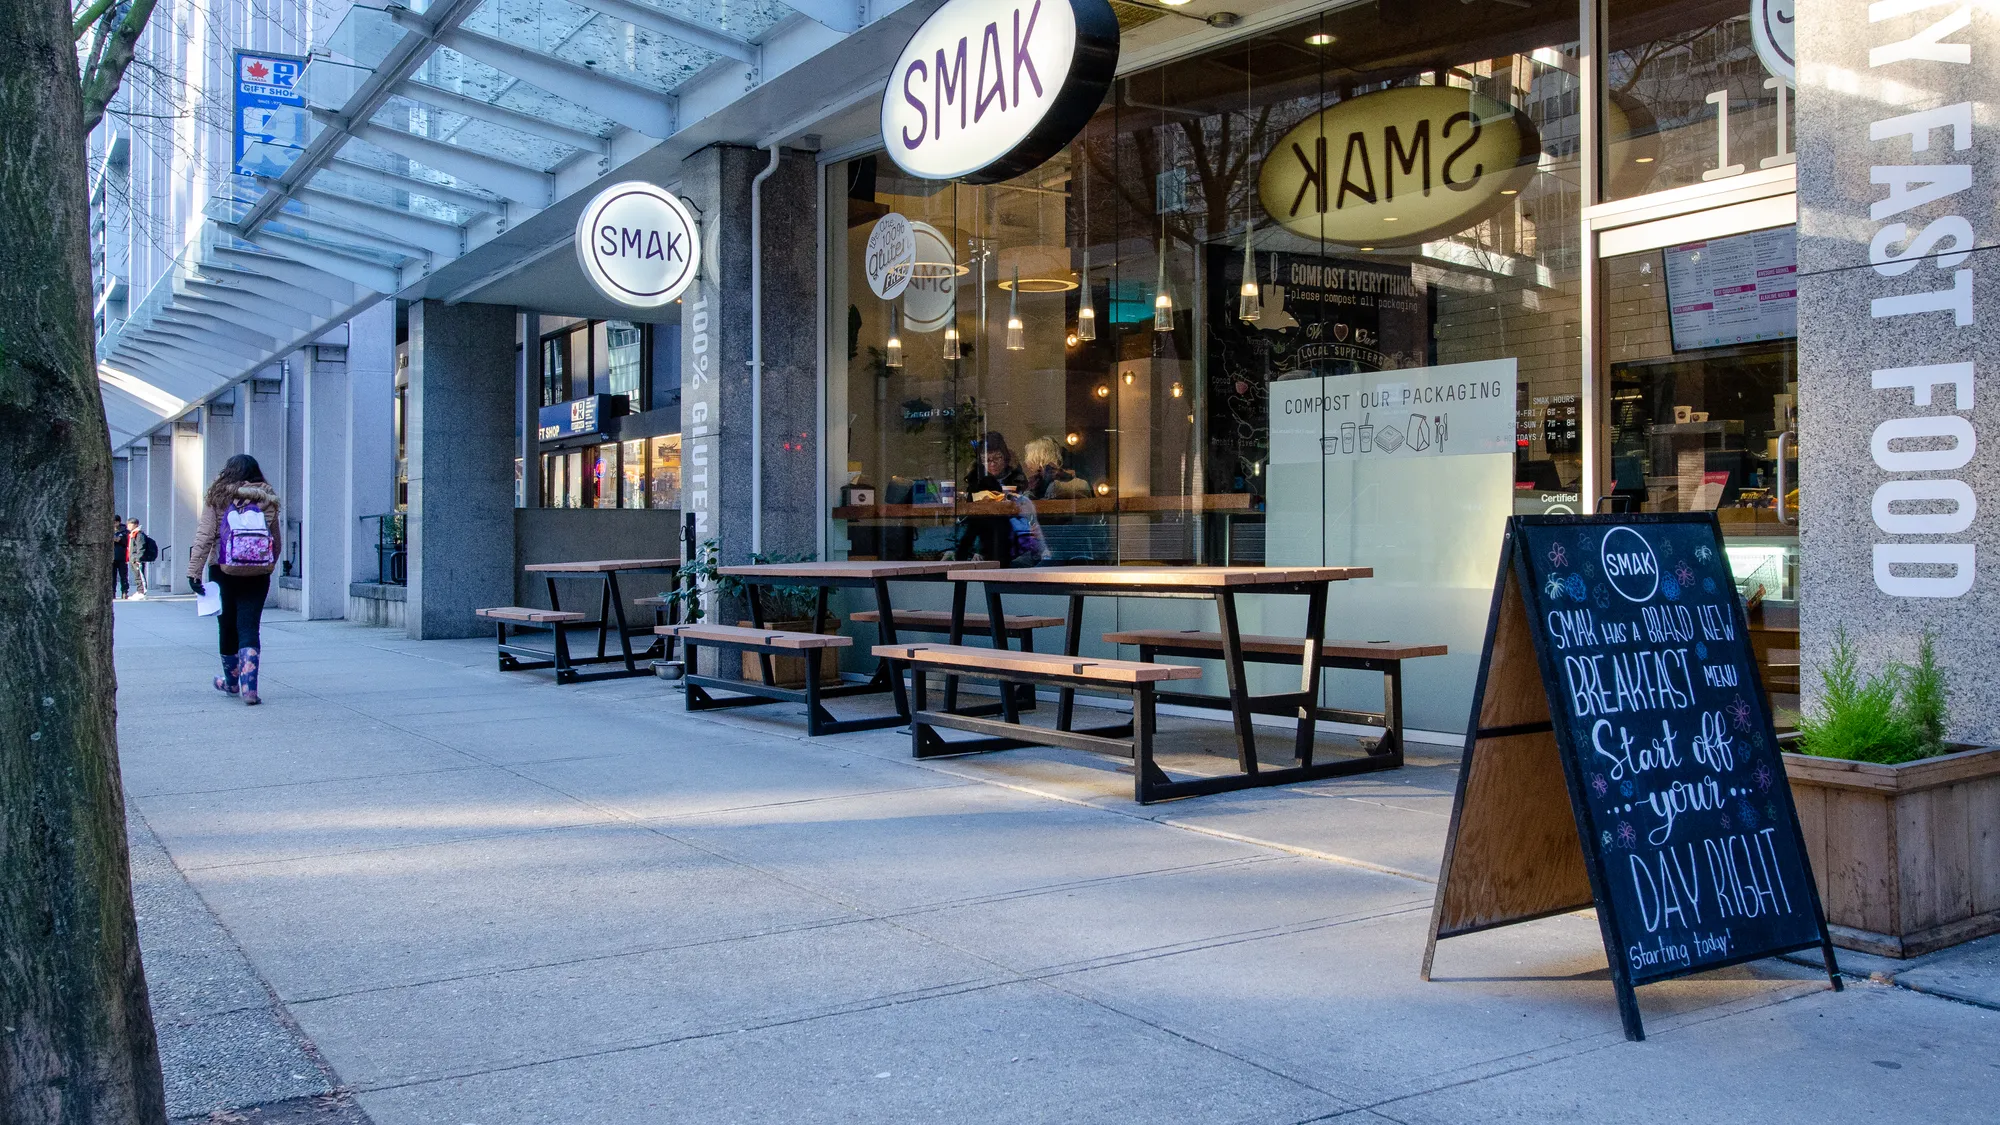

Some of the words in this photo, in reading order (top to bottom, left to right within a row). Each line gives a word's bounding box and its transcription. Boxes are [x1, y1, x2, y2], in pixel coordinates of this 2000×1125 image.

[243, 84, 267, 95] GIFT
[902, 0, 1044, 150] SMAK
[1870, 101, 1974, 326] FAST
[600, 225, 683, 263] SMAK
[1291, 262, 1346, 290] COMPOST
[1291, 289, 1320, 302] please
[1324, 294, 1357, 306] compost
[1360, 297, 1374, 307] all
[1378, 299, 1418, 314] packaging
[691, 295, 709, 390] 100%
[1301, 346, 1329, 360] LOCAL
[1334, 347, 1385, 366] SUPPLIERS
[1285, 394, 1350, 415] COMPOST
[1360, 391, 1390, 409] OUR
[1402, 380, 1502, 406] PACKAGING
[1553, 395, 1575, 404] HOURS
[546, 425, 560, 438] SHOP
[1541, 493, 1578, 503] Certified
[1870, 361, 1977, 599] FOOD
[1606, 551, 1656, 576] SMAK
[1547, 609, 1599, 649] SMAK
[1601, 622, 1627, 645] HAS
[1632, 621, 1641, 641] A
[1642, 604, 1694, 643] BRAND
[1697, 603, 1735, 642] NEW
[1565, 649, 1696, 717] BREAKFAST
[1703, 664, 1738, 687] MENU
[1591, 719, 1683, 780] Start
[1692, 711, 1734, 772] off
[1629, 843, 1701, 933] DAY
[1704, 828, 1792, 918] RIGHT
[1629, 935, 1691, 970] Starting
[1693, 928, 1735, 958] today!
